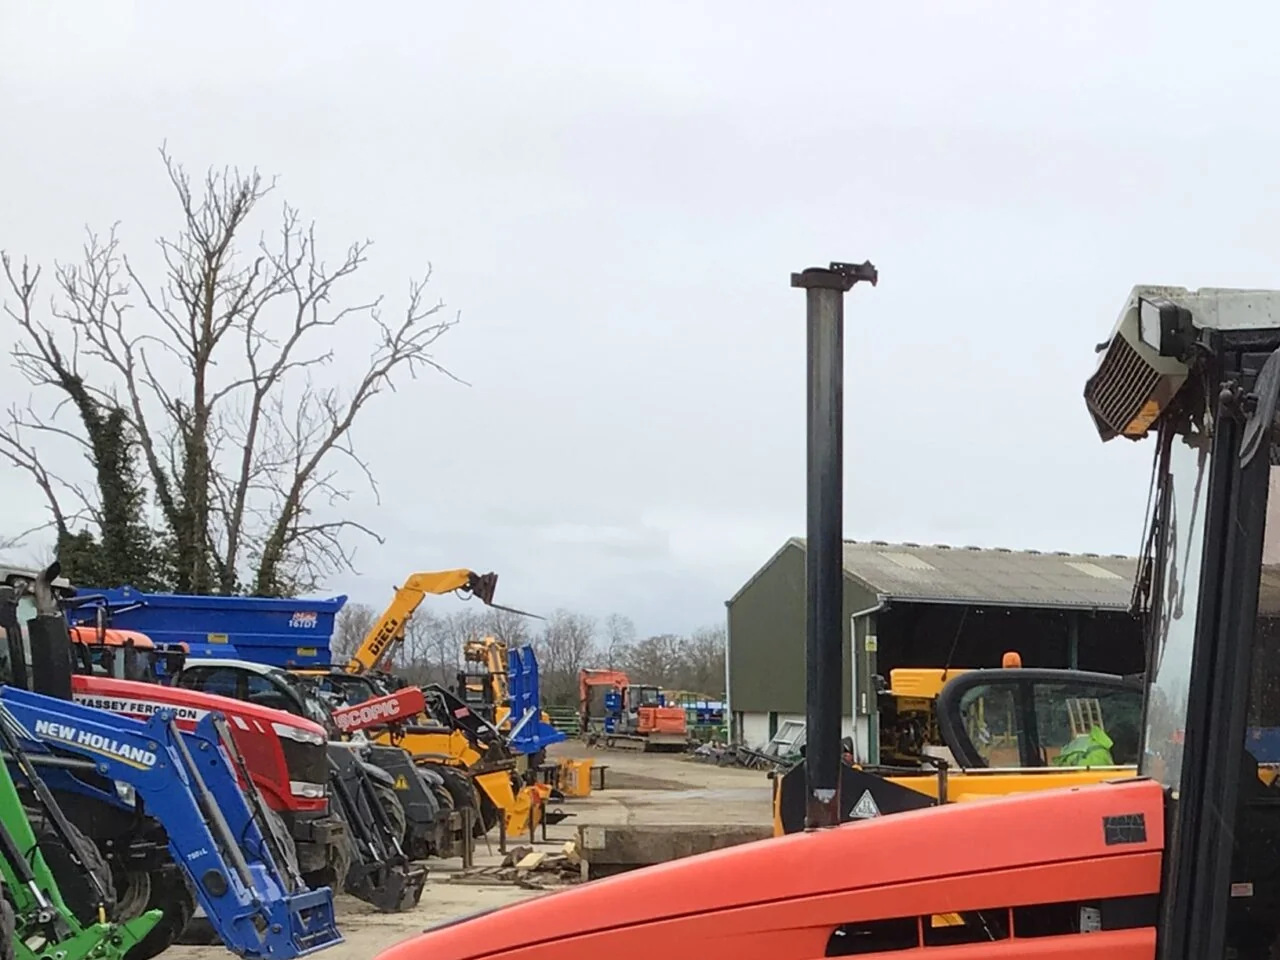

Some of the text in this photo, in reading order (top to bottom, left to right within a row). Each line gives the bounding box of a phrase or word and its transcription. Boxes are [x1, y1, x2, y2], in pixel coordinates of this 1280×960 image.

[367, 618, 398, 656] DIECI
[129, 703, 197, 719] FERGSON
[35, 719, 157, 766] NEW HOLLAND
